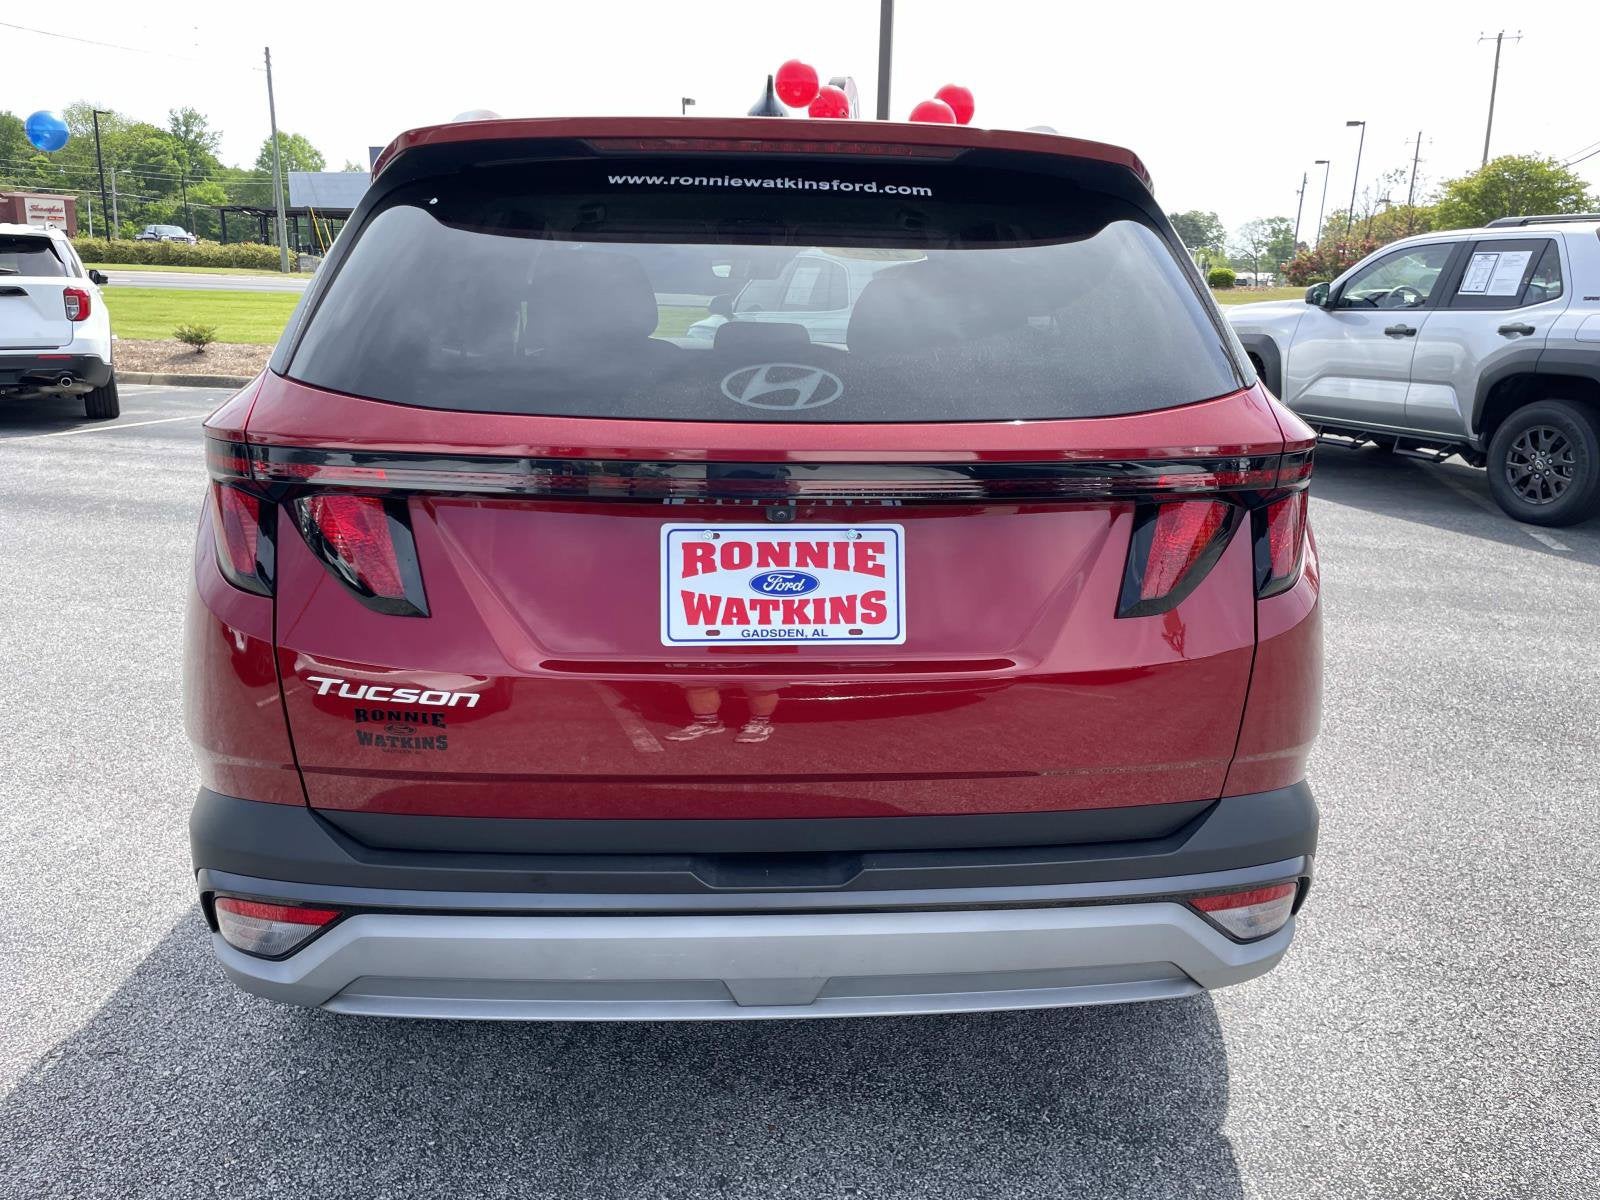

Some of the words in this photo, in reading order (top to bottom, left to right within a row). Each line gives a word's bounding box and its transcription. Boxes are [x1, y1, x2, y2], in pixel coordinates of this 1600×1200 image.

[608, 175, 932, 197] www.ronniewatkinsford.com
[682, 541, 885, 578] RONNIE
[762, 573, 805, 592] Ford
[681, 590, 887, 626] WATKINS
[741, 629, 808, 639] GADSDEN,
[812, 629, 829, 638] AL
[355, 708, 447, 729] RONNIE
[356, 730, 448, 751] WATKINS
